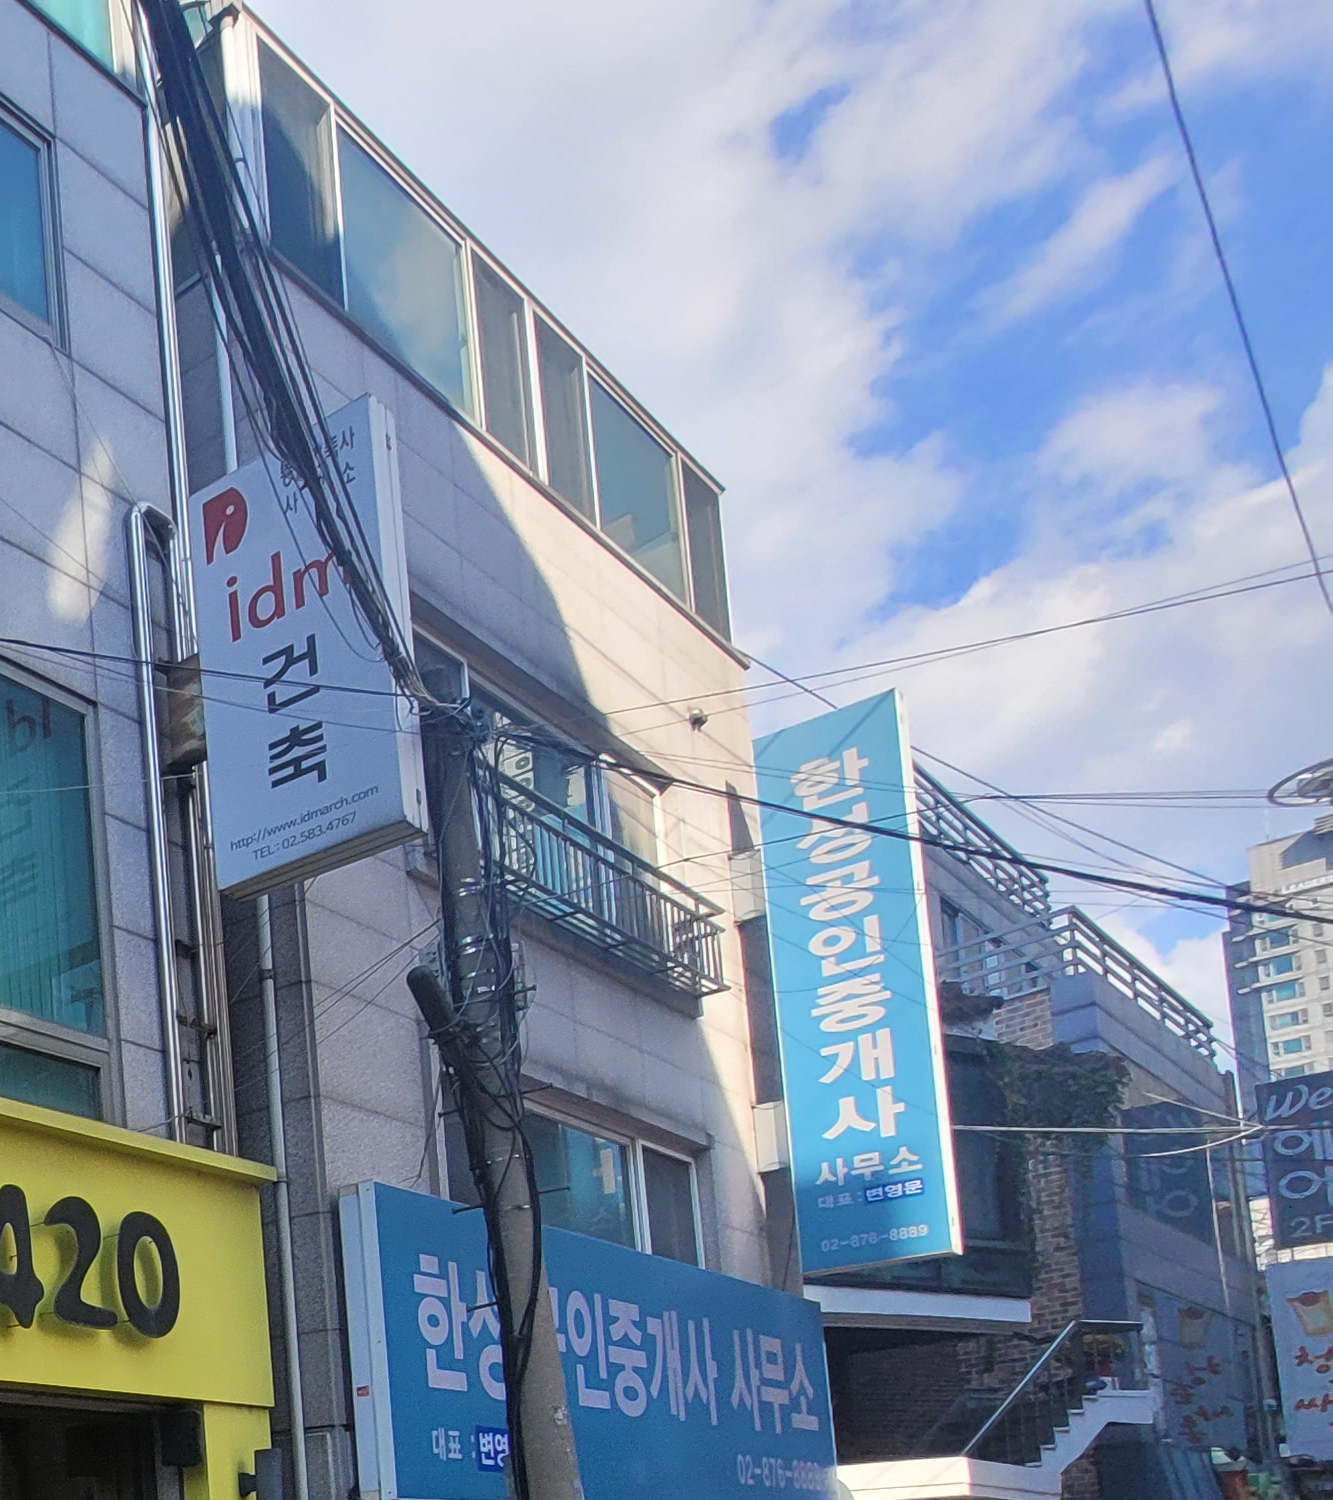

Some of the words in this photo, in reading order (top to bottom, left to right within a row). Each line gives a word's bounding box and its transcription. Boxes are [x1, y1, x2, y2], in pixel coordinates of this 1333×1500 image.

[262, 633, 327, 789] 건축
[230, 785, 379, 851] http://www.idmarch.com
[282, 811, 357, 850] 02.583.4767
[789, 747, 906, 1141] 한성공인중개사
[815, 1146, 923, 1186] 사무소
[413, 1253, 719, 1426] 한인중개사
[730, 1327, 820, 1435] 사무소
[431, 1427, 463, 1461] 대표
[478, 1430, 510, 1468] 변영
